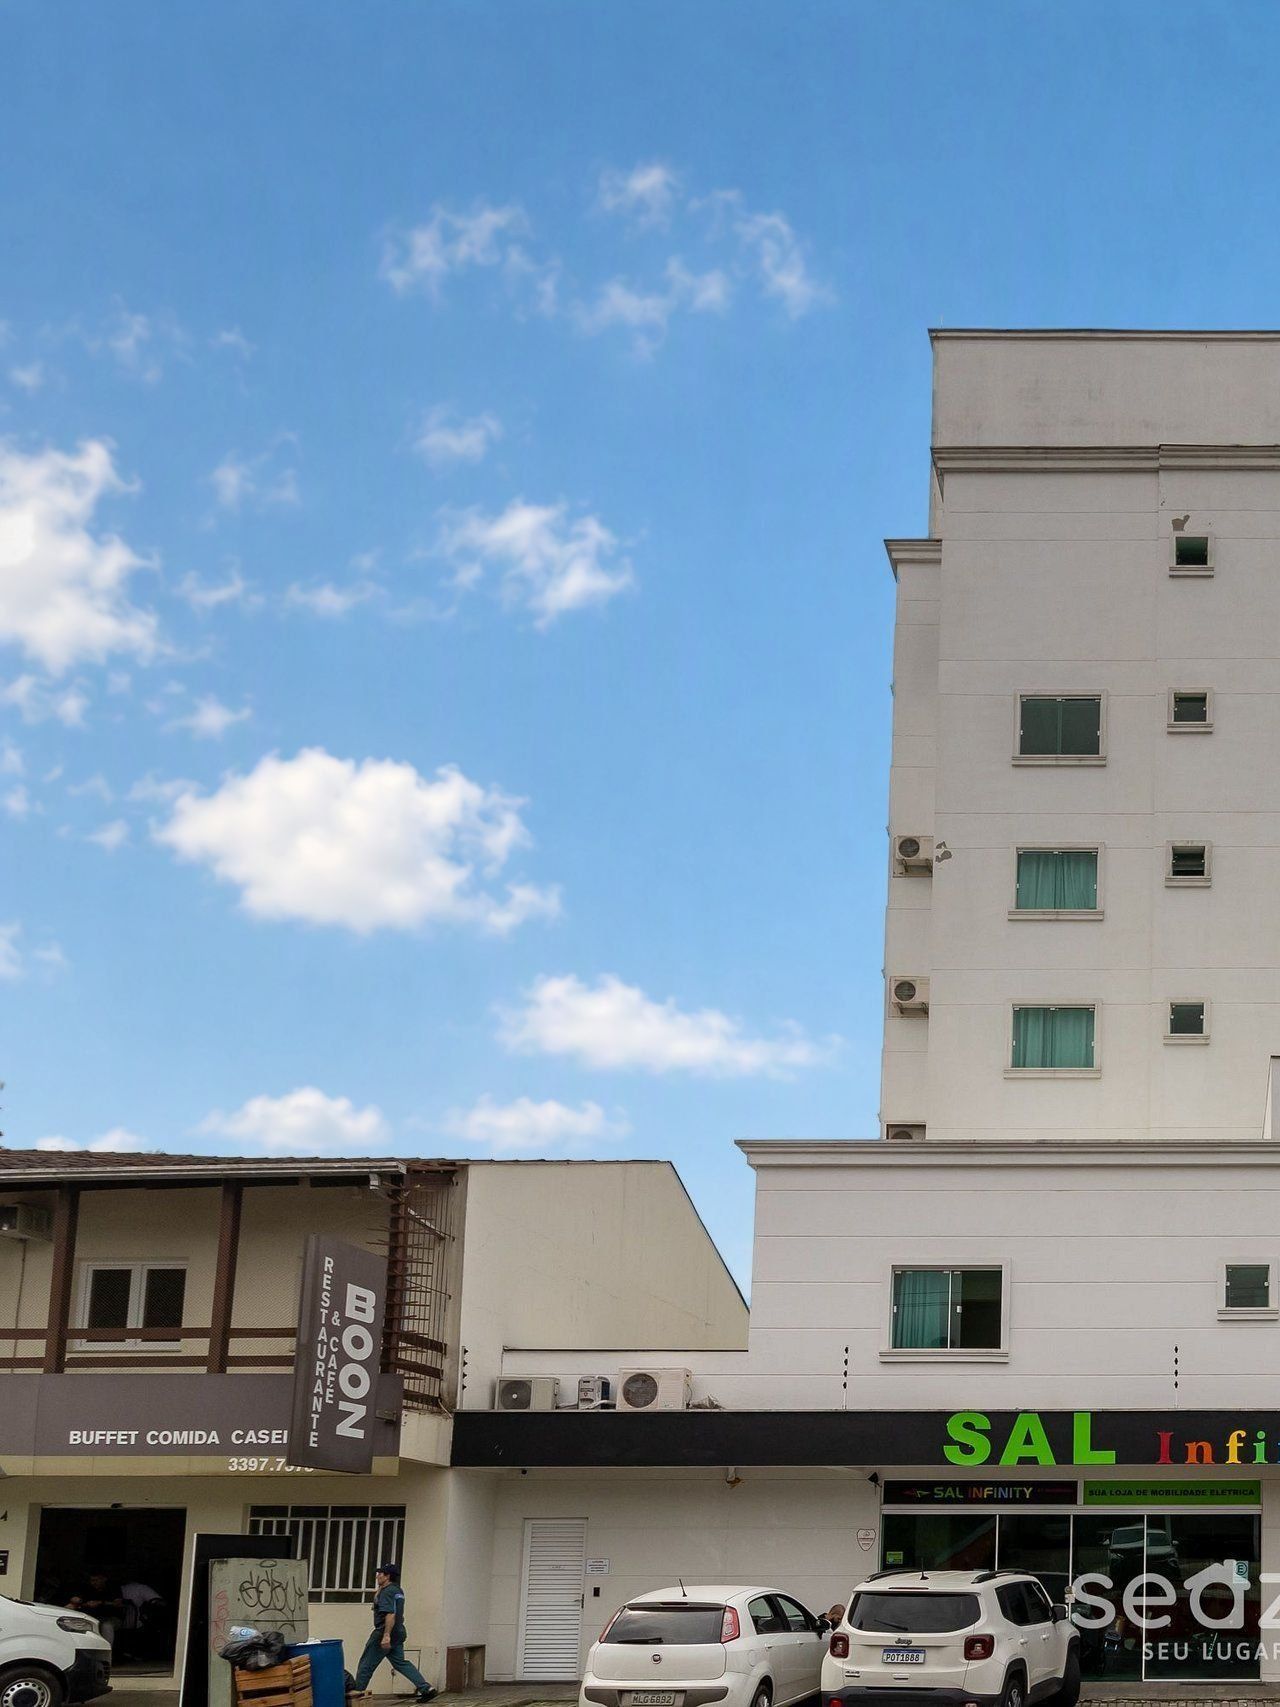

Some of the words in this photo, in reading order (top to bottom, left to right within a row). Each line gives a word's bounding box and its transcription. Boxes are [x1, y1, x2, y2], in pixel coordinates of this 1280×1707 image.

[331, 1310, 342, 1327] &
[309, 1256, 334, 1448] RESTAURANTE
[335, 1283, 376, 1439] BOOZ
[325, 1336, 340, 1404] CAFÉ
[69, 1430, 139, 1445] BUFFET
[146, 1430, 220, 1445] COMIDA
[943, 1412, 1116, 1466] SAL
[933, 1486, 964, 1499] SAL
[968, 1487, 1034, 1499] INFINITY
[1089, 1488, 1107, 1497] SUA
[1110, 1488, 1133, 1497] LOJA
[1136, 1488, 1148, 1497] DE
[1150, 1488, 1207, 1497] MOBILIDADE
